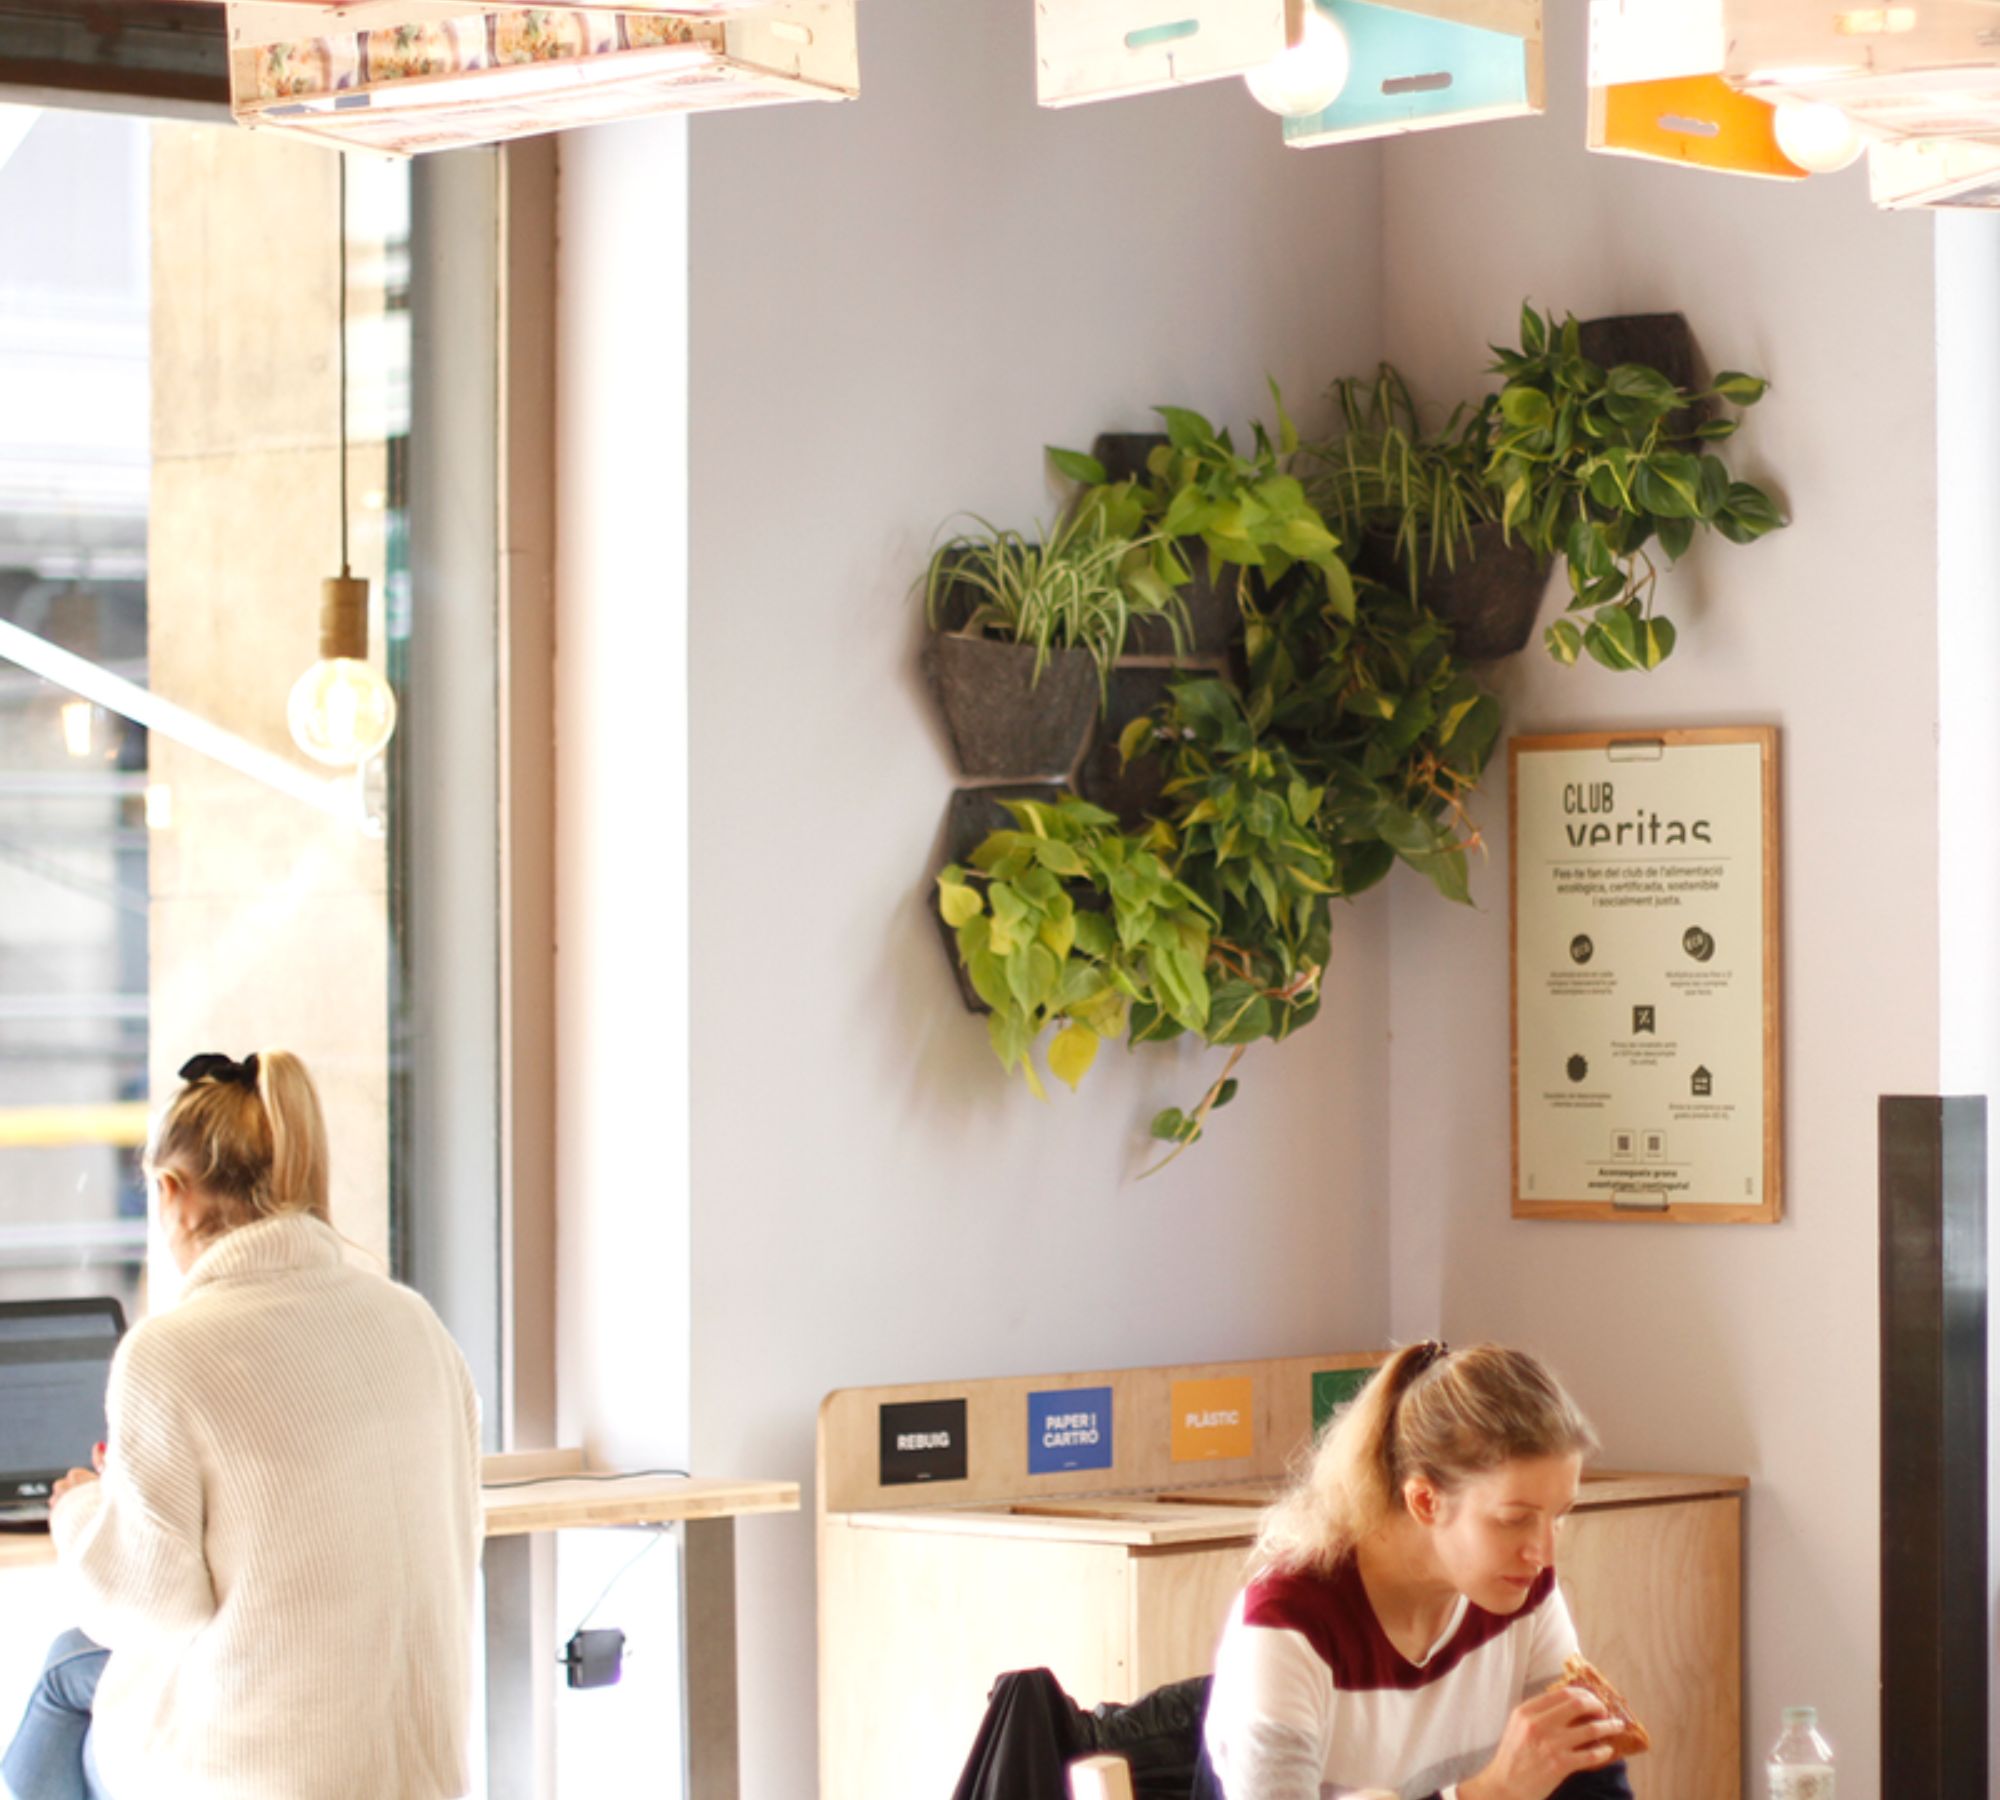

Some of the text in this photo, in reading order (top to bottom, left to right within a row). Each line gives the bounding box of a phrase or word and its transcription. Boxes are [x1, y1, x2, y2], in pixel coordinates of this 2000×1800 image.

[1563, 782, 1614, 814] CLUB
[1565, 809, 1712, 847] veritas
[1587, 866, 1602, 878] fan
[1605, 866, 1620, 878] del
[1622, 866, 1643, 878] club
[1645, 866, 1658, 878] de
[1667, 879, 1719, 891] sostenible
[1045, 1413, 1088, 1431] PAPER
[896, 1429, 951, 1452] REBUIG
